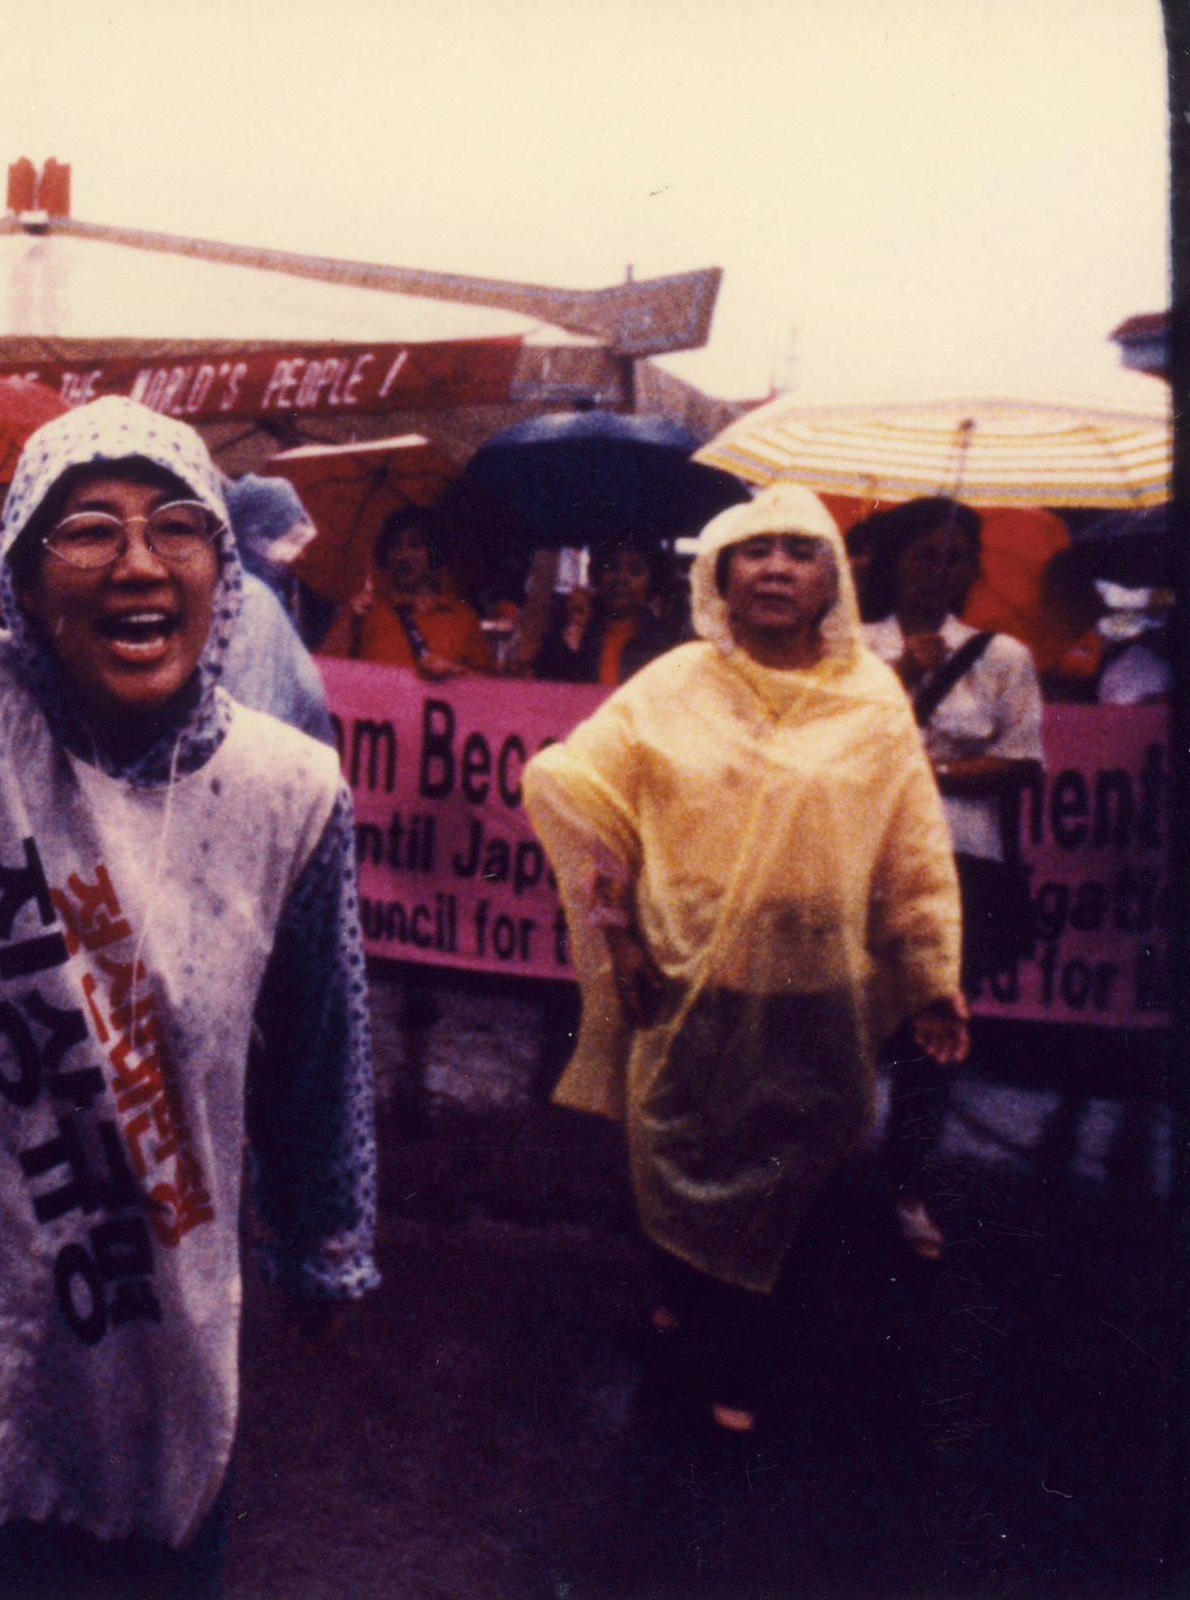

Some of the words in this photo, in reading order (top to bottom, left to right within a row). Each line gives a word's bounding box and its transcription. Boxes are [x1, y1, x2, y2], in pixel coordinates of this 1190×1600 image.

[260, 356, 375, 408] PEOPLE
[419, 697, 559, 809] Bec
[453, 816, 558, 897] Jap
[475, 898, 538, 963] for
